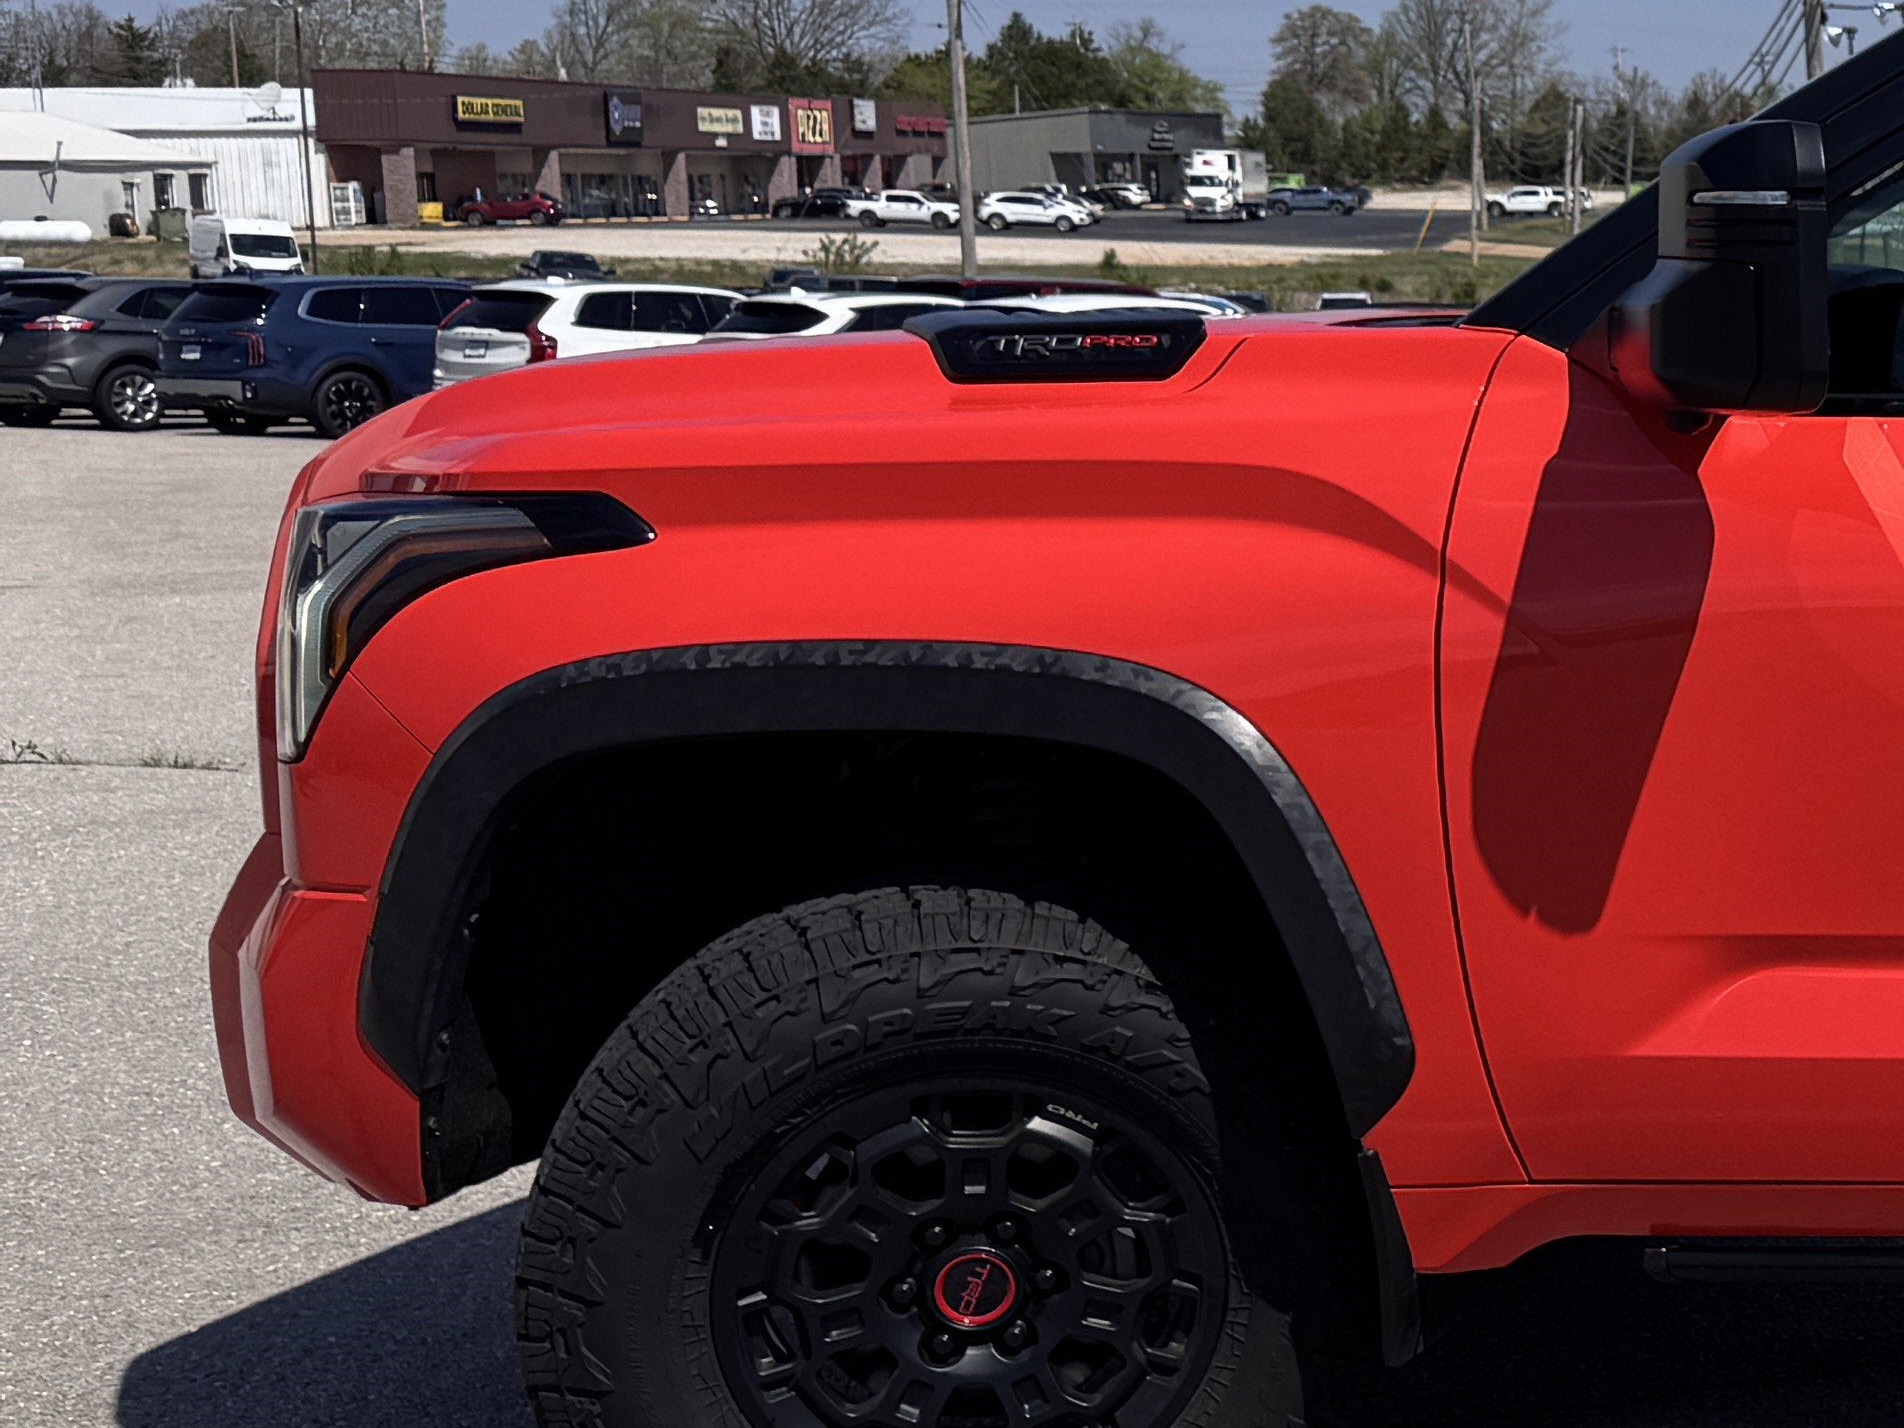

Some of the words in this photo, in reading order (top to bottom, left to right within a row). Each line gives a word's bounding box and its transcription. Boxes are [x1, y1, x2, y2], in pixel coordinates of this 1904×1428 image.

[797, 108, 831, 144] PIZZA
[1081, 334, 1159, 349] PRO
[682, 999, 1078, 1166] WILDPEAK
[958, 1263, 993, 1315] TRD
